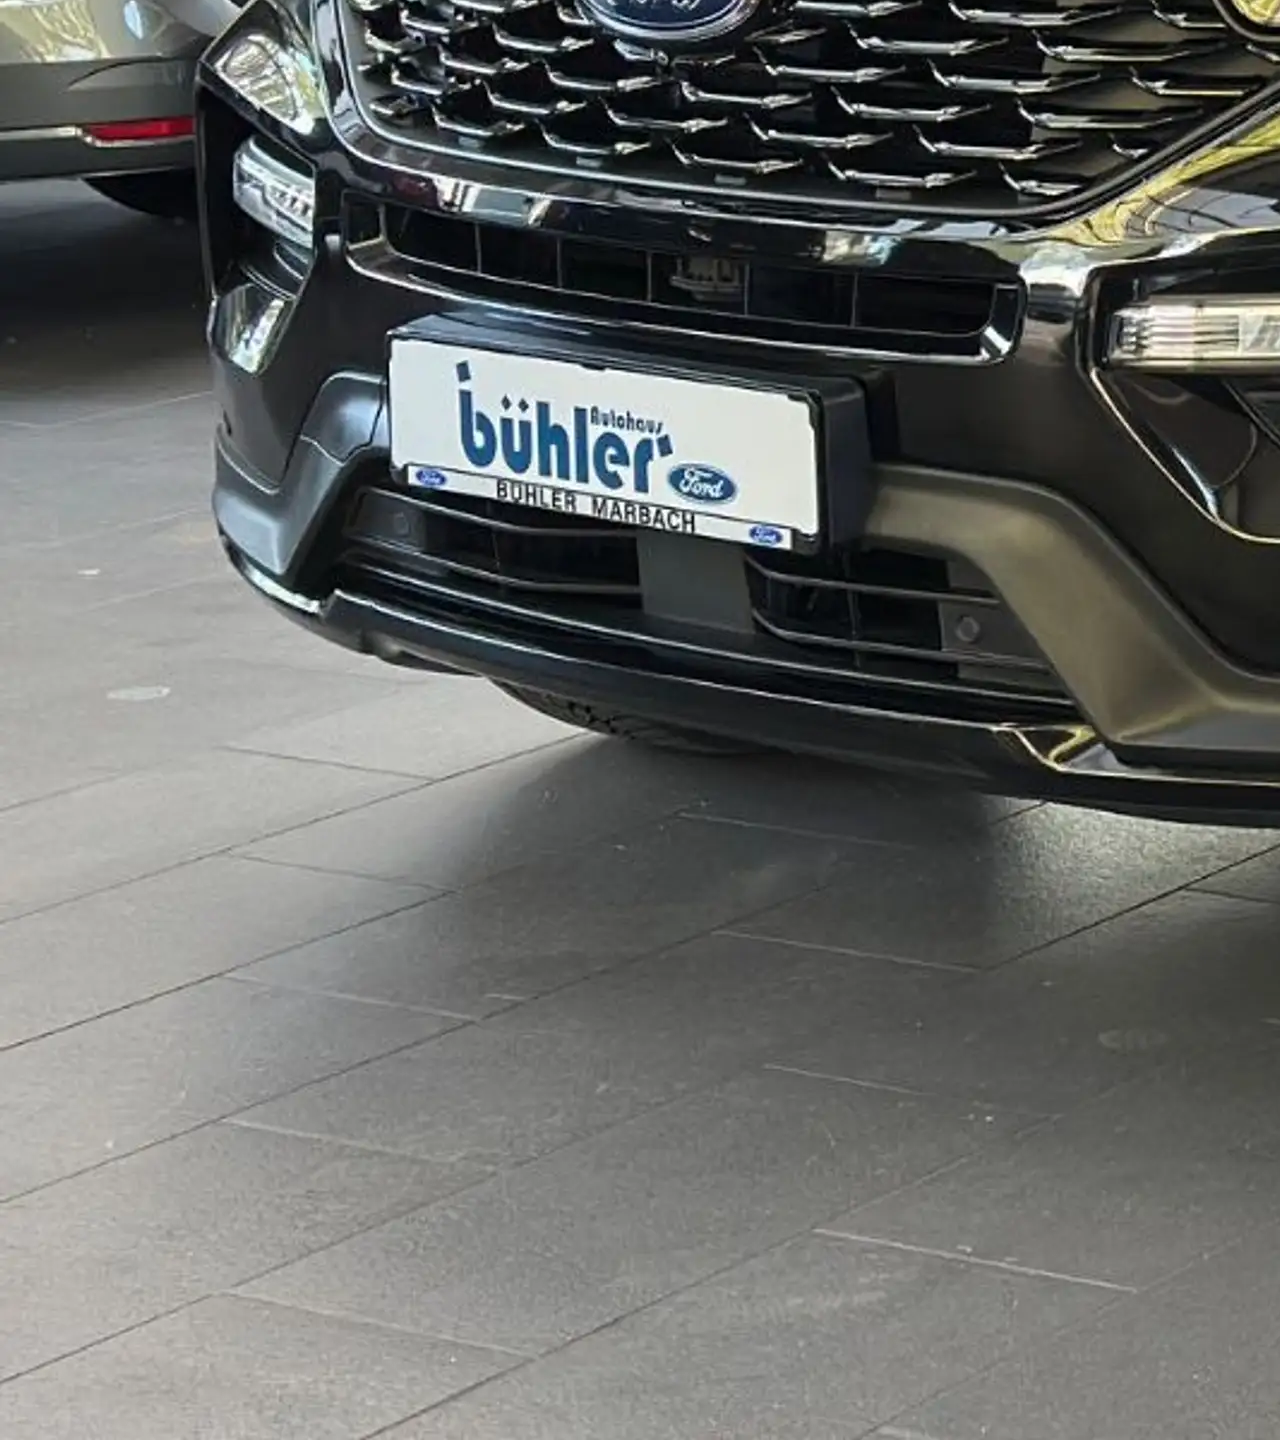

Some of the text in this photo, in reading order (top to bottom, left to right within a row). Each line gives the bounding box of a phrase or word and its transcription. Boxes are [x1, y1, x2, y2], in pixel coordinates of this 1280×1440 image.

[455, 359, 674, 494] bühler
[678, 467, 727, 499] Ford
[592, 495, 696, 533] MARBACH
